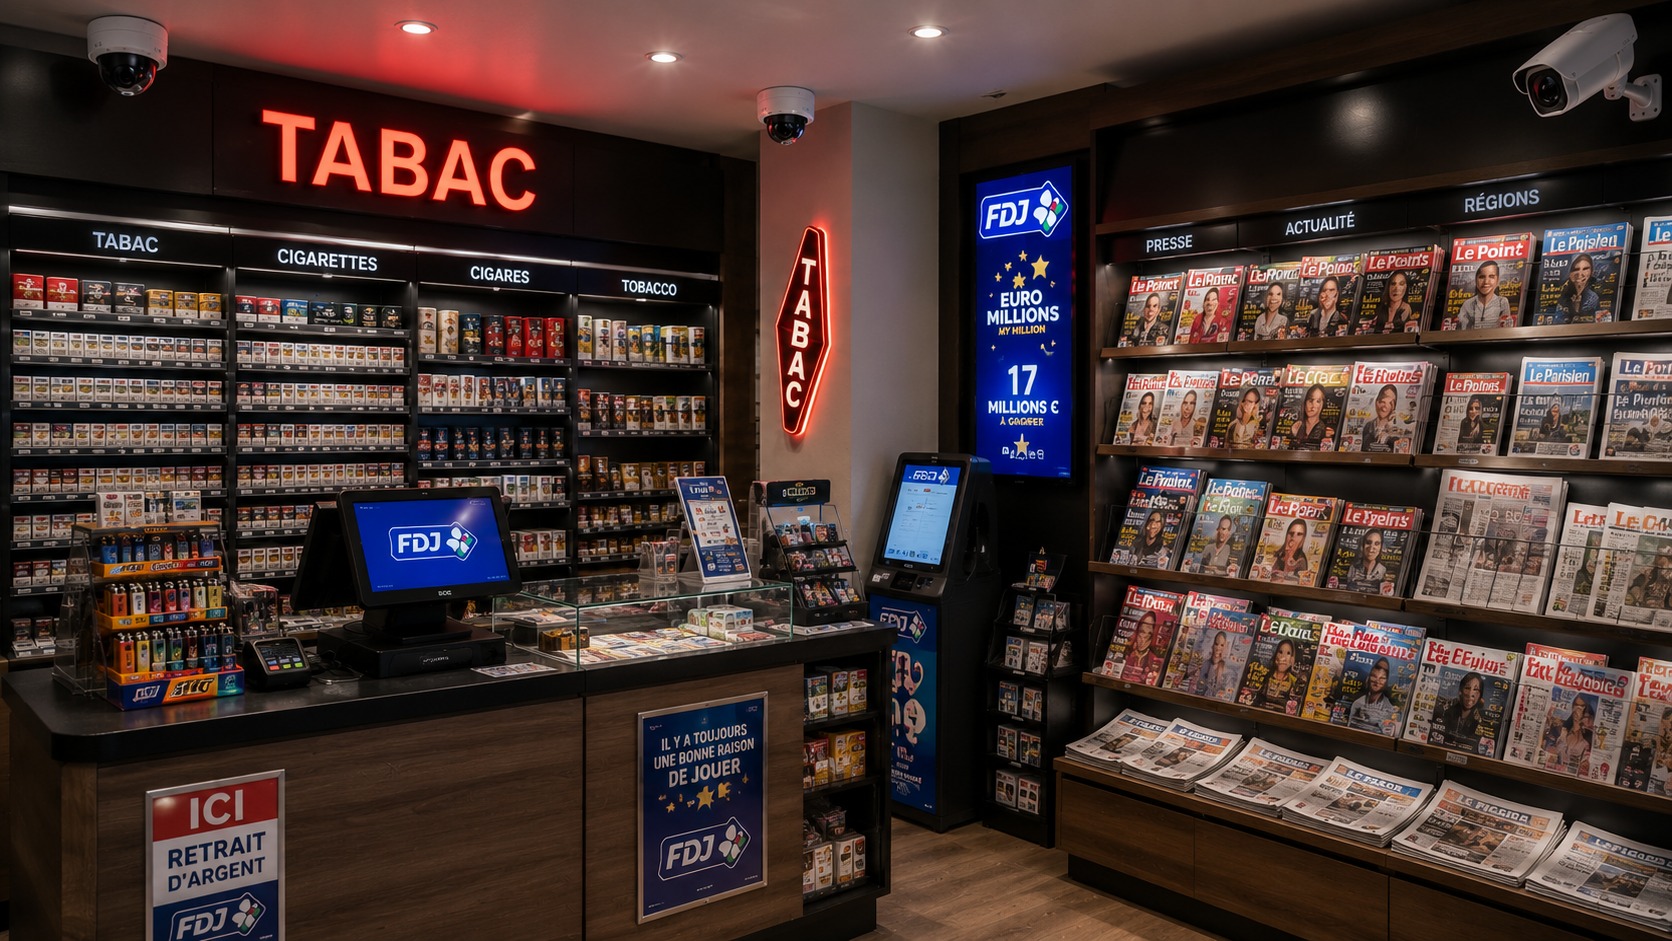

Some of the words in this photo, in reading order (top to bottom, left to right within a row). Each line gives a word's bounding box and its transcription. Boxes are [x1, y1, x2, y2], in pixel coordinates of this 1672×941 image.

[262, 109, 536, 211] TABAC
[1464, 188, 1540, 214] RÉGIONS
[985, 199, 1029, 230] FDJ
[1285, 211, 1355, 236] ACTUALITÉ
[92, 230, 159, 254] TABAC
[1146, 234, 1193, 253] PRESSE
[1455, 246, 1474, 261] Le
[1477, 243, 1524, 259] Point
[1550, 237, 1566, 252] Le
[277, 248, 378, 272] CIGARETTES
[1369, 256, 1386, 269] Le
[470, 265, 530, 284] CIGARES
[622, 279, 678, 296] TOBACCO
[1000, 290, 1043, 308] EURO
[987, 305, 1060, 326] MILLIONS
[786, 258, 817, 408] TABAC
[998, 327, 1011, 336] MY
[1008, 364, 1038, 395] 17
[1530, 368, 1543, 382] Le
[988, 400, 1047, 414] MILLIONS
[1050, 400, 1059, 414] €
[1346, 509, 1360, 523] Le
[398, 532, 441, 554] FDJ
[661, 737, 671, 751] IL
[673, 735, 681, 748] Y
[683, 733, 691, 746] A
[694, 723, 748, 744] TOUJOURS
[654, 753, 676, 770] UNE
[679, 745, 715, 764] BONNE
[717, 737, 755, 757] RAISON
[668, 768, 688, 788] DE
[690, 757, 741, 784] JOUER
[190, 789, 244, 830] ICI
[168, 831, 266, 869] RETRAIT
[666, 834, 716, 870] FDJ
[168, 856, 266, 892] D'ARGENT
[176, 907, 228, 940] FDJ
